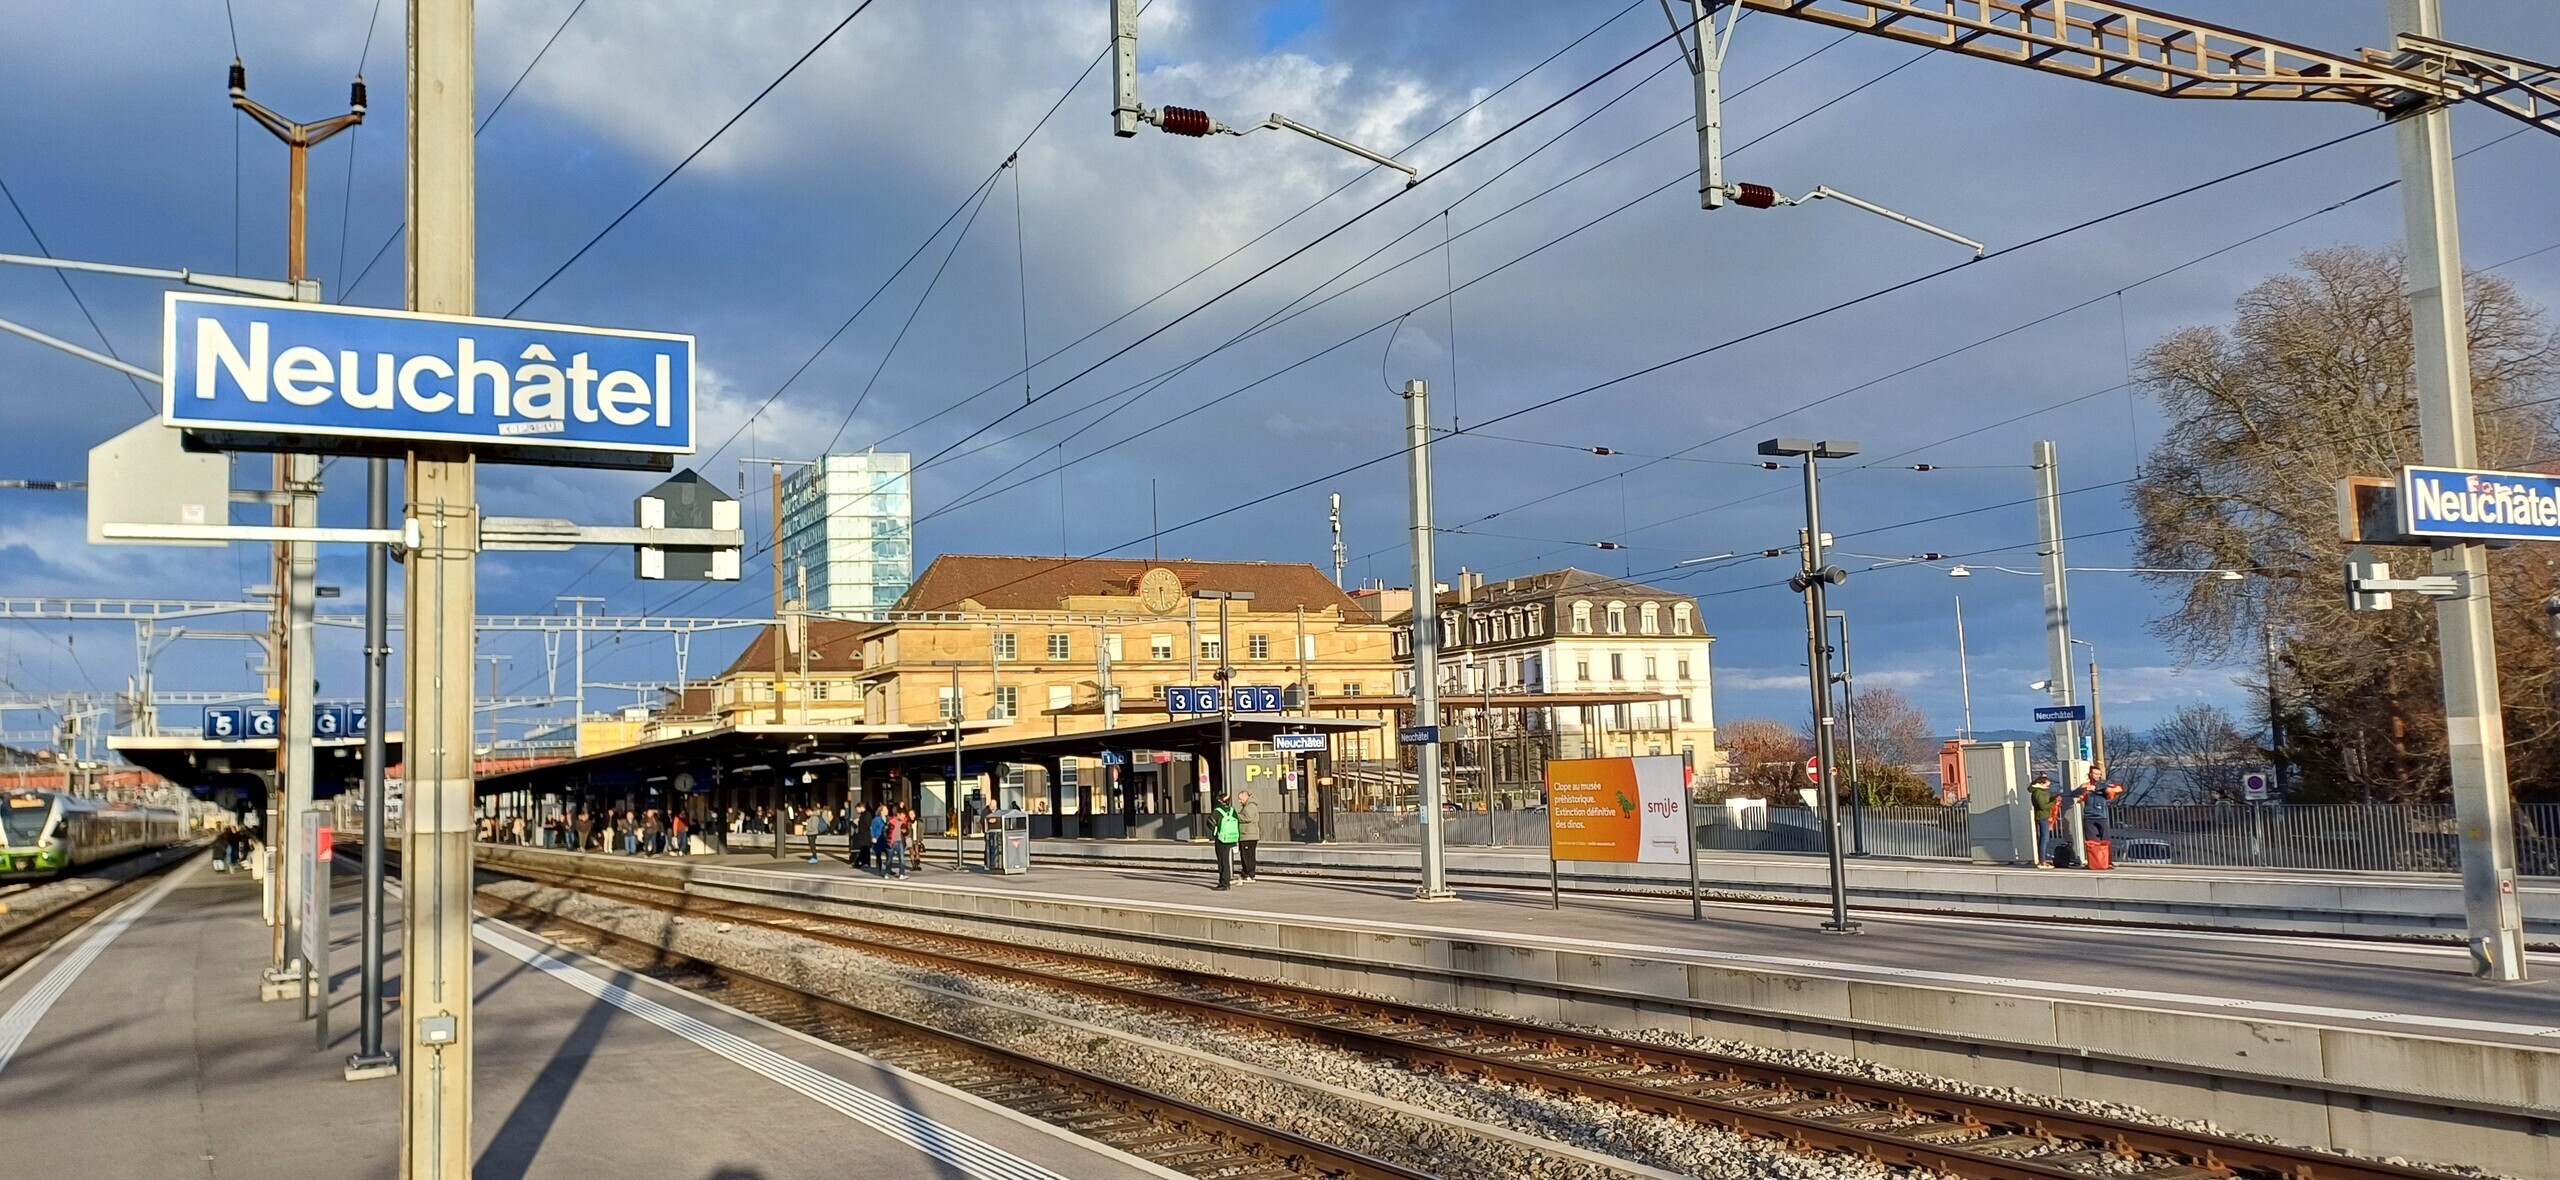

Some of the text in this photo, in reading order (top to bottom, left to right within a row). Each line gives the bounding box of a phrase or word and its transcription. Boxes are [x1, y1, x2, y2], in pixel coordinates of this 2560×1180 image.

[196, 317, 670, 427] Neuchâtel
[1176, 694, 1212, 709] 3 G
[1240, 694, 1276, 709] G 2
[2036, 710, 2074, 720] Neuchâtel
[215, 715, 275, 736] 5 G
[317, 714, 337, 733] G
[1276, 736, 1325, 749] Neuchâtel
[1401, 731, 1429, 742] Neuchâtel
[1554, 782, 1571, 793] Clope
[1580, 781, 1601, 790] musée
[1554, 794, 1596, 805] préhistorique.
[1555, 807, 1616, 816] Extinction définitive
[1648, 798, 1678, 818] smile
[1555, 819, 1585, 828] des dinos.
